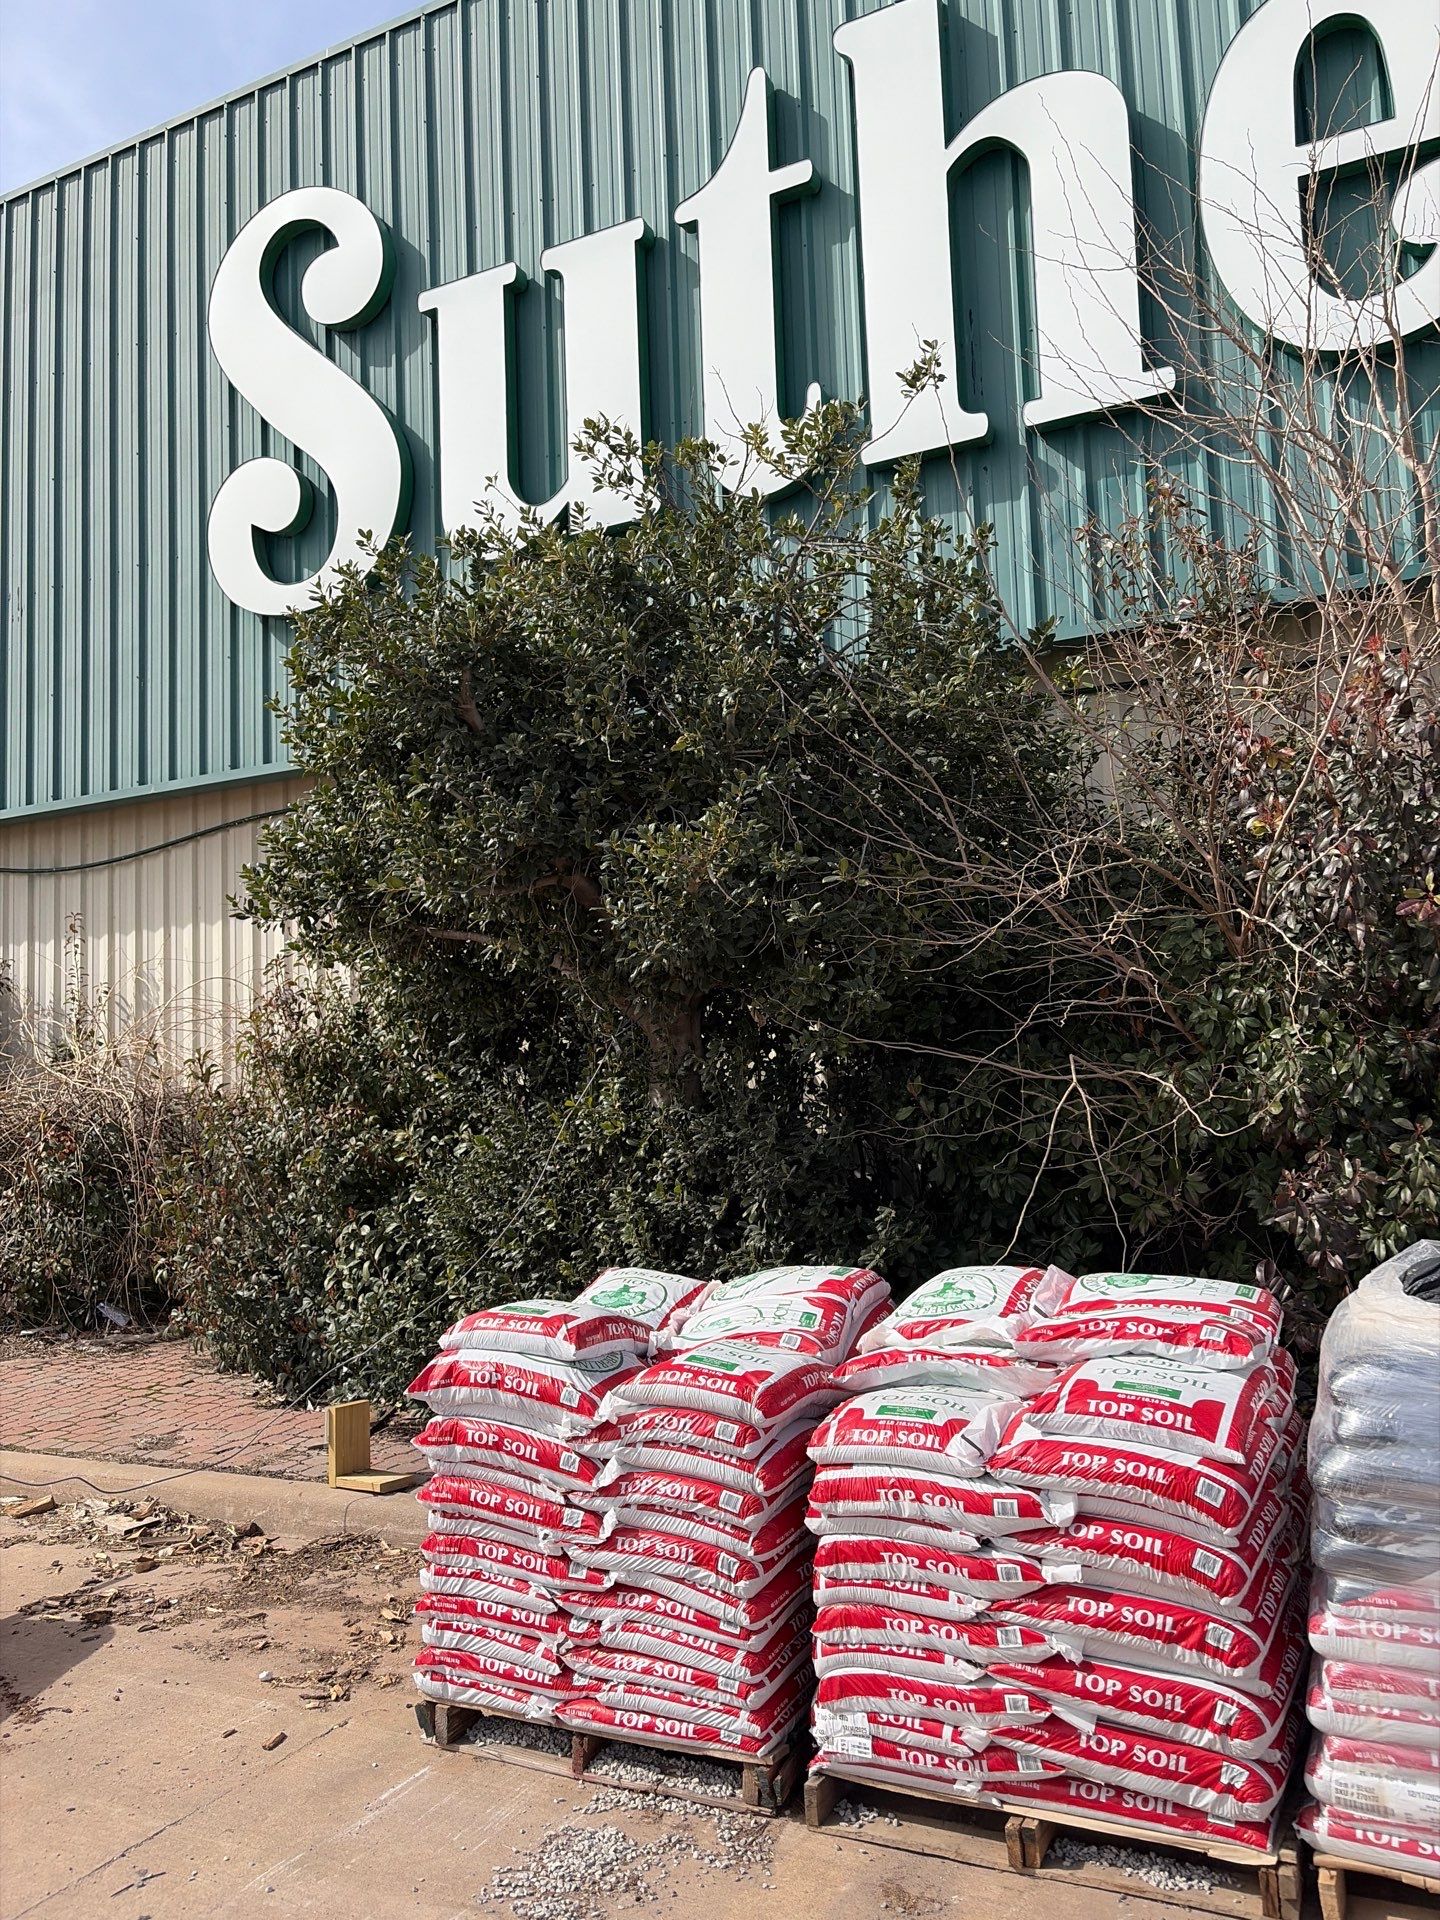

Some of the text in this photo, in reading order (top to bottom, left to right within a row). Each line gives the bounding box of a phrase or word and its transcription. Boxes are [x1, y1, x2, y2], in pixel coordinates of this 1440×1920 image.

[474, 1317, 544, 1332] TOP SOIL
[1078, 1320, 1120, 1332] TOP
[468, 1370, 501, 1384] TOP
[504, 1376, 541, 1397] SOIL
[658, 1370, 692, 1384] TOP
[696, 1376, 738, 1394] SOIL
[1096, 1367, 1148, 1376] TOP
[1153, 1372, 1214, 1392] SOIL
[917, 1394, 970, 1414] SOIL
[1086, 1399, 1196, 1432] TOP SOIL
[466, 1429, 540, 1462] TOP SOIL
[852, 1429, 944, 1450] TOP SOIL
[1060, 1451, 1170, 1484] TOP SOIL
[468, 1488, 502, 1507] TOP
[504, 1499, 544, 1520] SOIL
[659, 1484, 698, 1502] SOIL
[1110, 1529, 1165, 1556] SOIL
[1248, 1520, 1266, 1552] TOP
[476, 1542, 550, 1574] TOP SOIL
[615, 1537, 697, 1563] TOP SOIL
[476, 1600, 550, 1628] TOP SOIL
[616, 1591, 698, 1622] TOP SOIL
[1066, 1595, 1176, 1634] TOP SOIL
[1258, 1592, 1278, 1626] TOP
[882, 1616, 923, 1634] TOP
[1359, 1620, 1410, 1640] TOP
[678, 1630, 720, 1654] SOIL
[480, 1658, 512, 1674] TOP
[514, 1666, 553, 1685] SOIL
[614, 1654, 650, 1671] TOP
[653, 1662, 697, 1684] SOIL
[1073, 1670, 1186, 1714] TOP SOIL
[1269, 1672, 1290, 1709] TOP
[614, 1710, 651, 1727] TOP
[654, 1718, 698, 1738] SOIL
[877, 1713, 924, 1730] SOIL
[897, 1747, 940, 1766] TOP
[1077, 1730, 1191, 1774] TOP SOIL
[1068, 1780, 1116, 1802] TOP
[1122, 1792, 1178, 1816] SOIL
